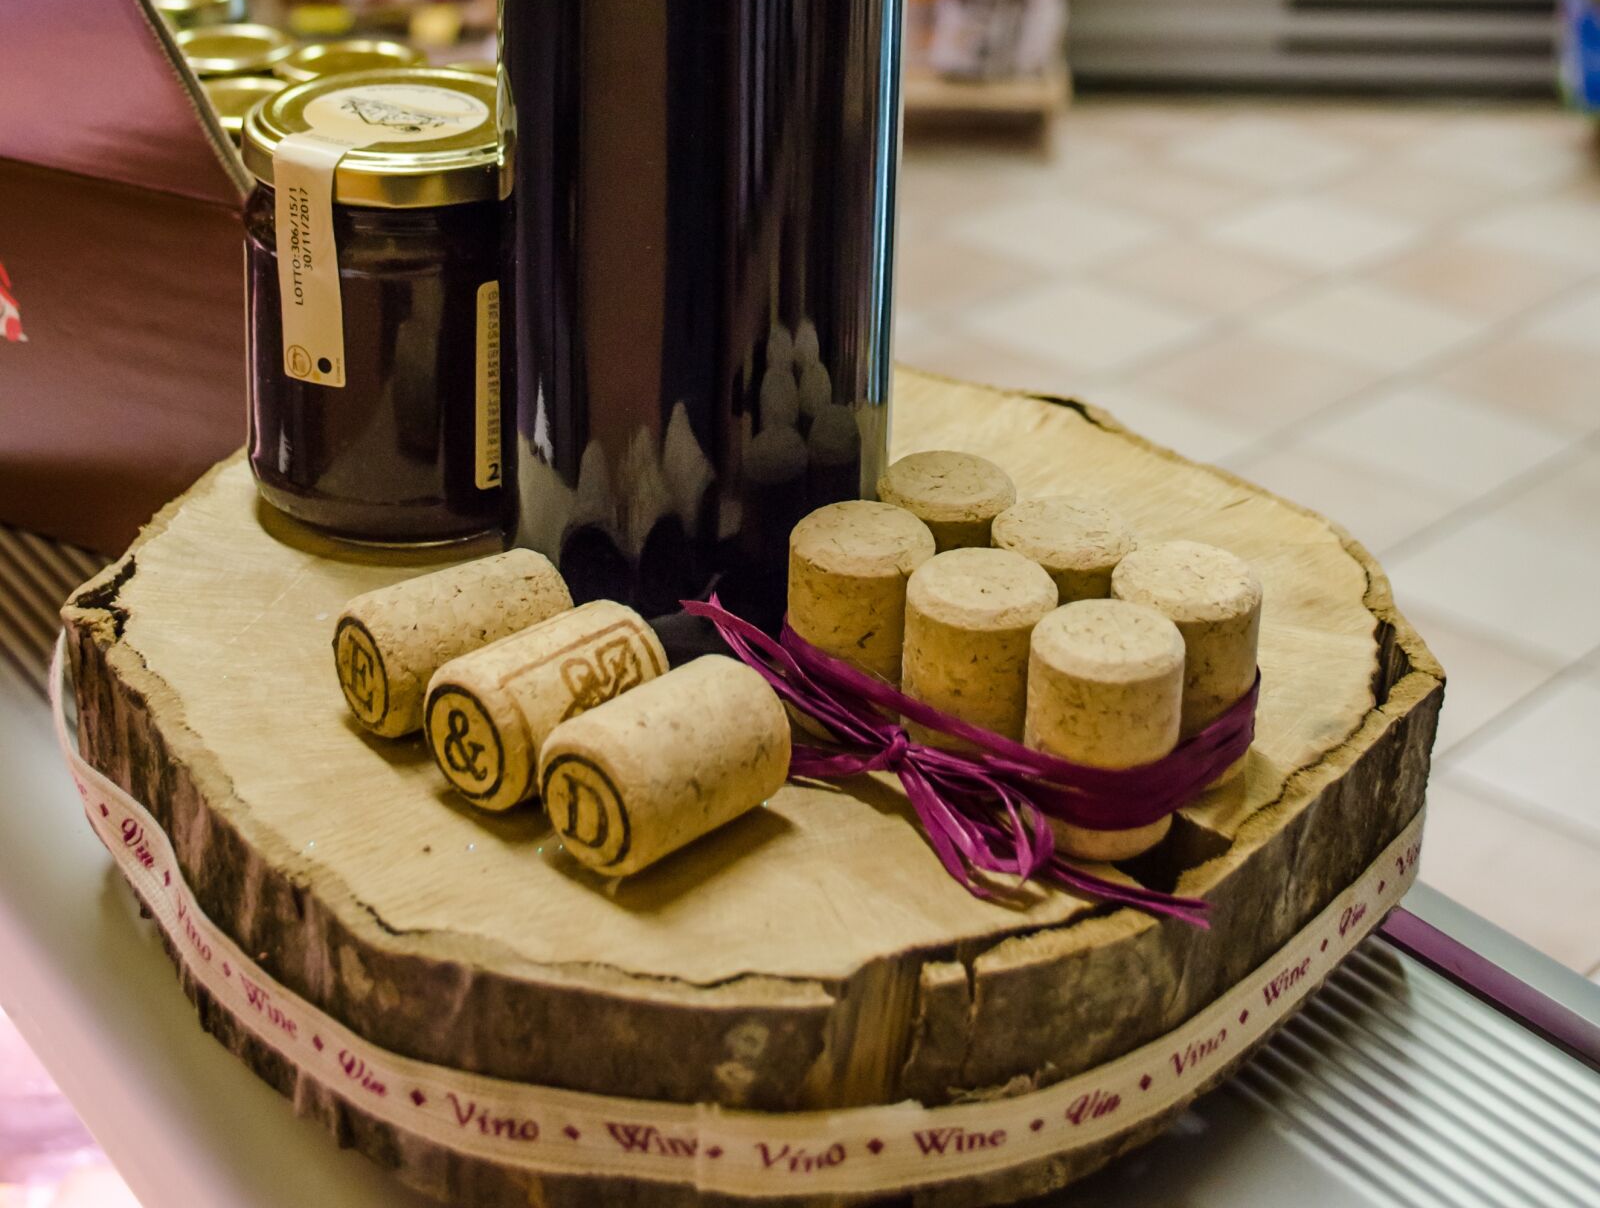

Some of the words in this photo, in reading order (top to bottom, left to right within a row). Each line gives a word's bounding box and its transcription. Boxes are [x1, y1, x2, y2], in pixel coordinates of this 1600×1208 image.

[444, 707, 488, 782] &
[562, 772, 610, 849] D
[240, 972, 298, 1040] Wine
[447, 1092, 539, 1142] Vino
[755, 1142, 847, 1173] Vino
[913, 1125, 1007, 1156] Wine
[1169, 1028, 1228, 1079] Vino
[1262, 957, 1311, 1007] Wine
